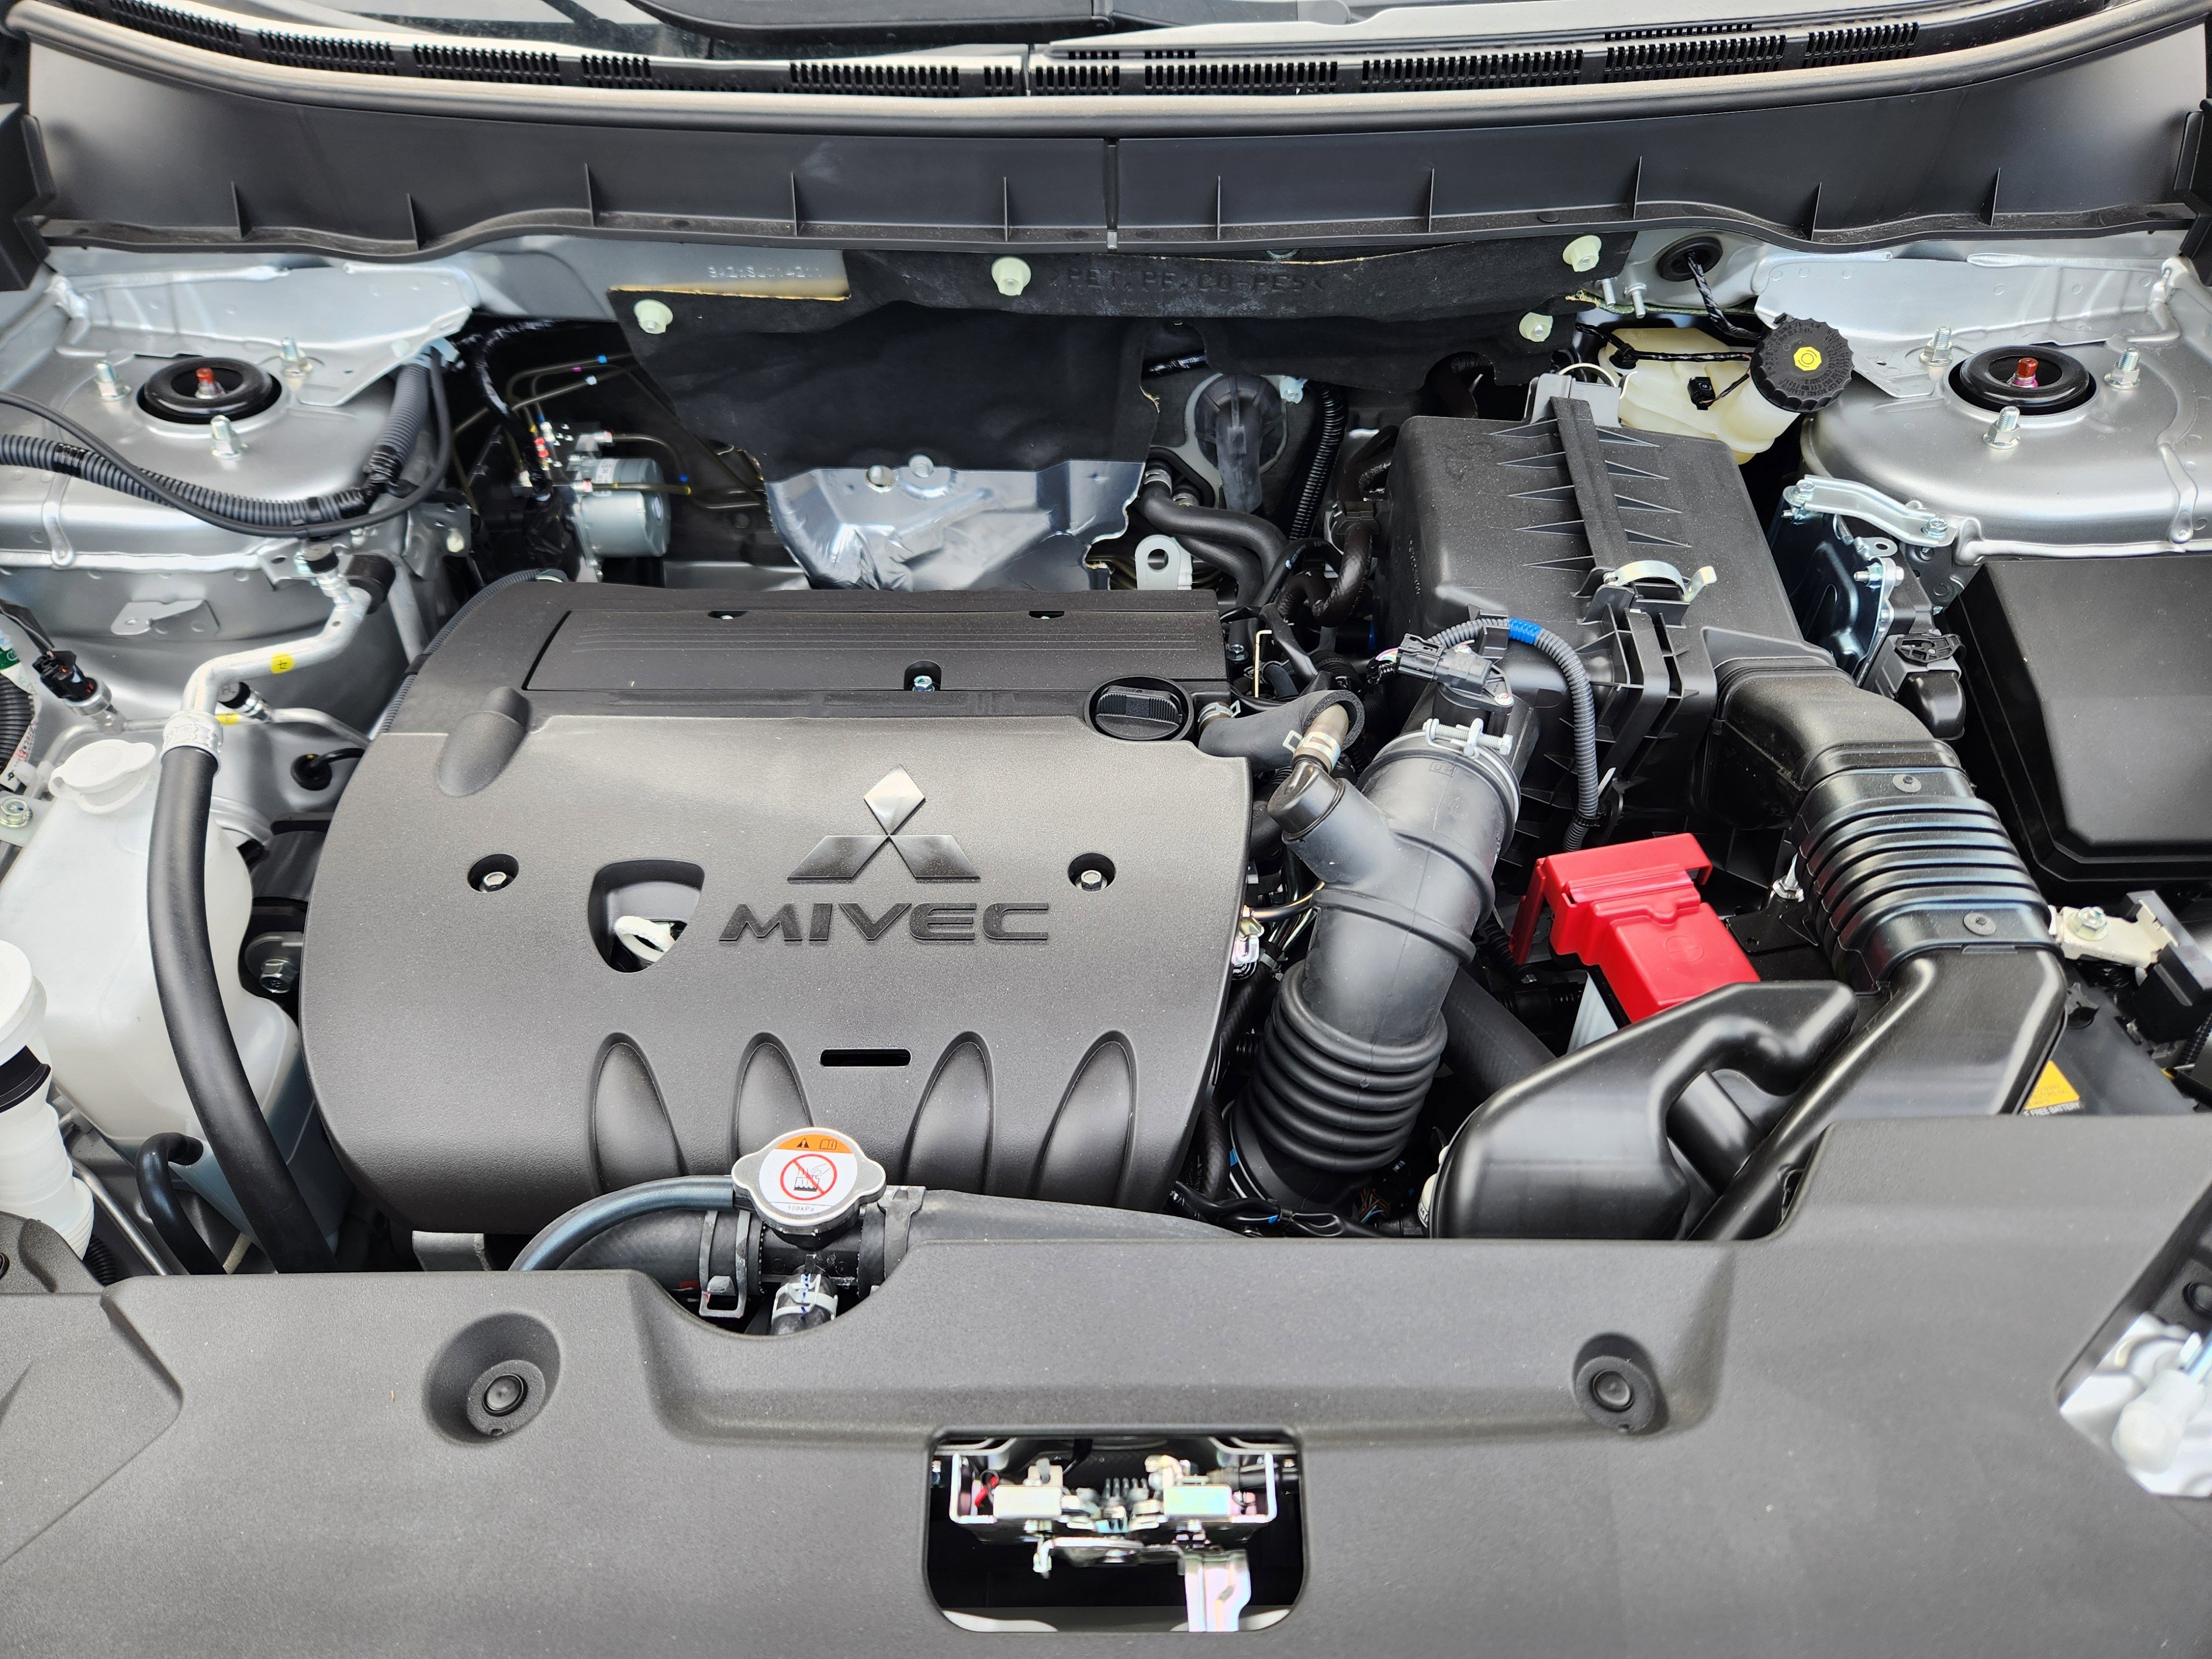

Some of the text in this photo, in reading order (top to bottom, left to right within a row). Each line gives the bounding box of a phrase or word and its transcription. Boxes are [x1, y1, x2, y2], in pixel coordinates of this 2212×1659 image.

[719, 902, 1048, 941] MIVEC
[2030, 1108, 2050, 1117] FREE
[2048, 1102, 2080, 1114] BATTERY
